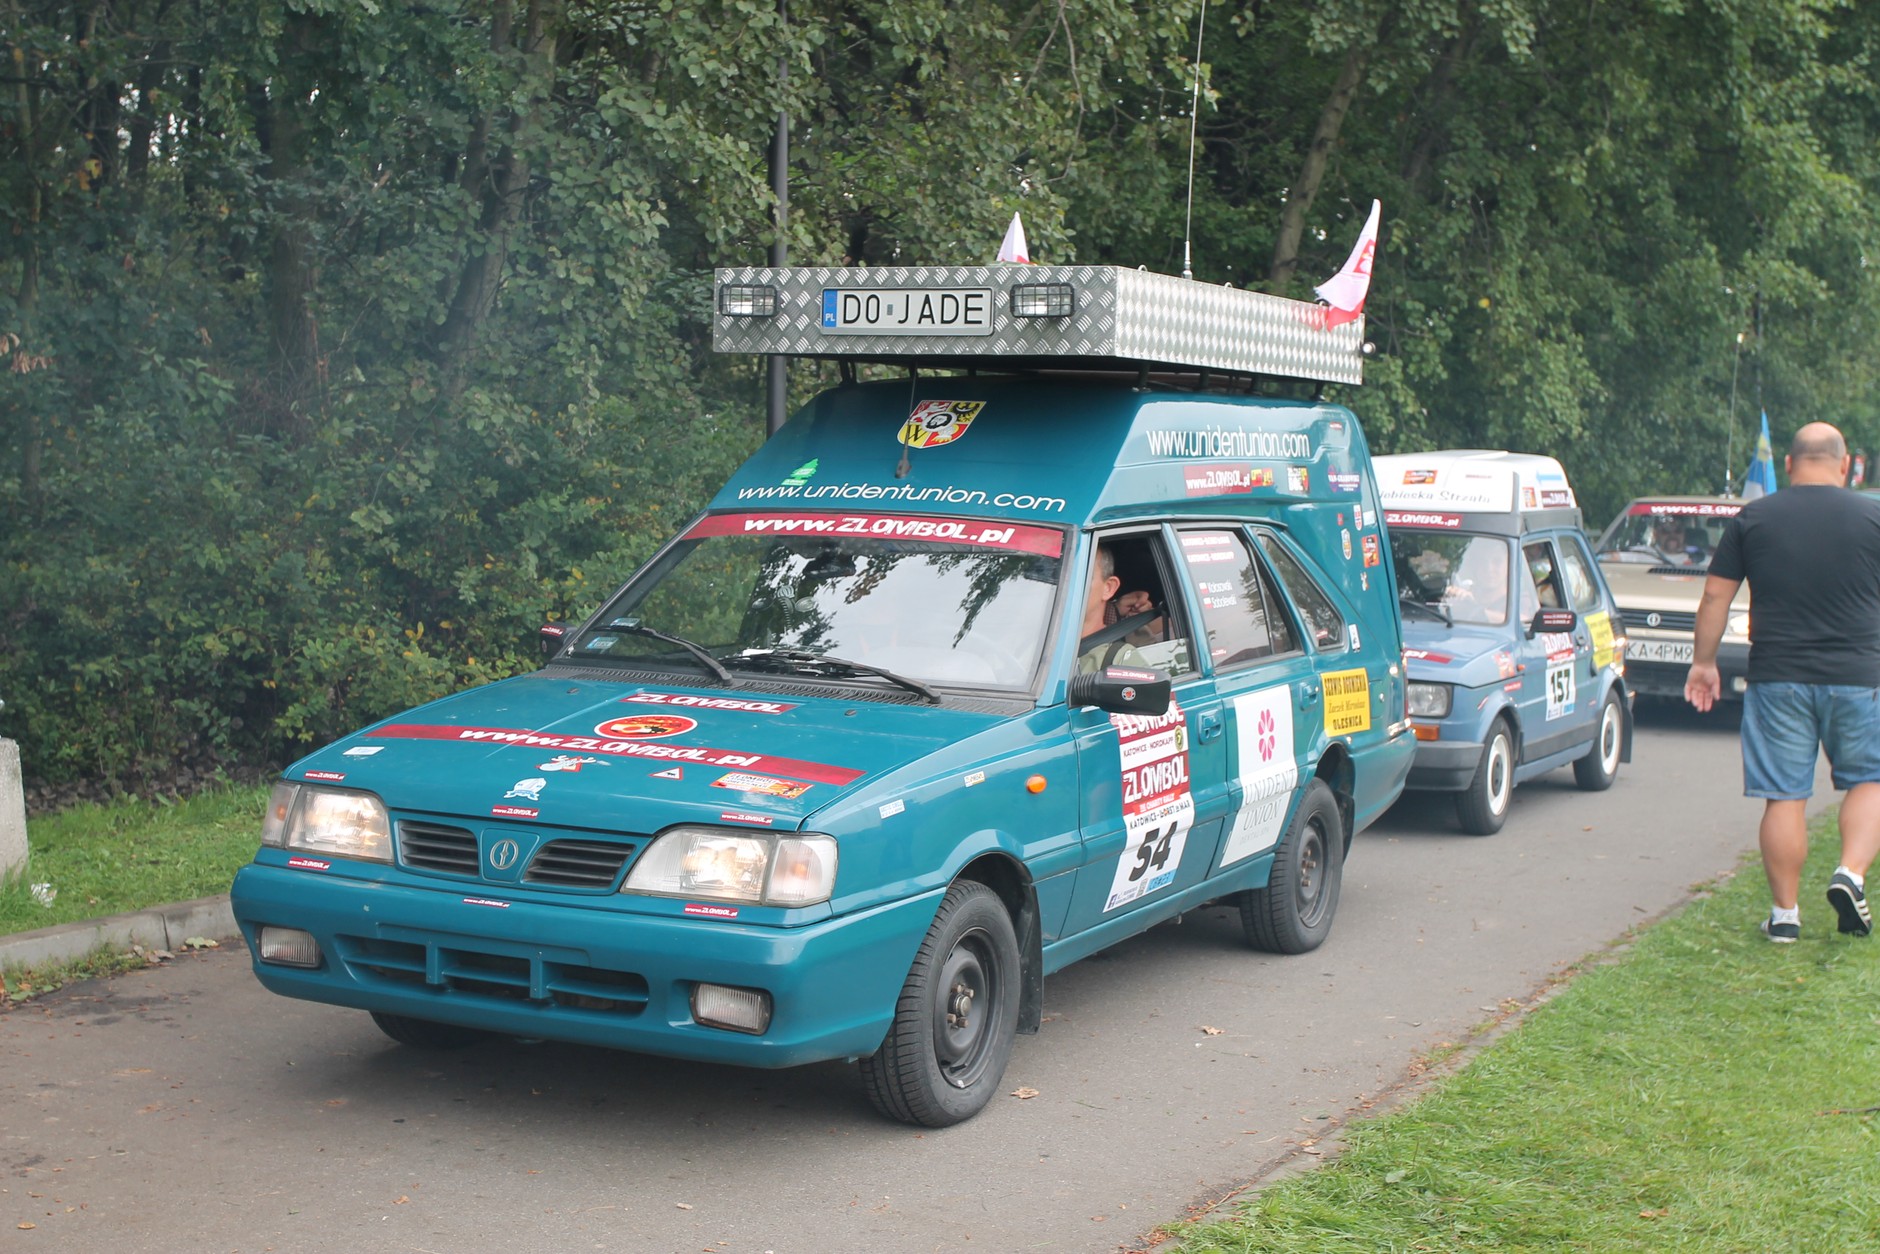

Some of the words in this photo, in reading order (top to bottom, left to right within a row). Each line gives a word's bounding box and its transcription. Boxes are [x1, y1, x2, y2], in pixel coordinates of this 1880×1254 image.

[825, 313, 835, 322] PL
[898, 294, 984, 324] JADE
[1146, 424, 1311, 458] www.unidentunion.com
[1186, 471, 1250, 490] www.ZLOMBOL.pl
[737, 483, 1066, 513] www.unidentunion.com
[743, 517, 1016, 545] www.ZLOMBOL.pl
[1551, 669, 1571, 704] 157
[627, 693, 781, 713] ZLOMBOL
[459, 728, 763, 768] www.ZLOMBOL.pl
[1123, 744, 1147, 758] KATOWICE
[1122, 755, 1189, 804] ZLOMBOL
[1245, 768, 1296, 805] UNIDENT
[721, 813, 773, 825] www.ZLOMBOL.pl
[1243, 798, 1282, 831] UNION
[1128, 820, 1178, 882] 54
[684, 906, 738, 917] www.ZLOMBOL.pl
